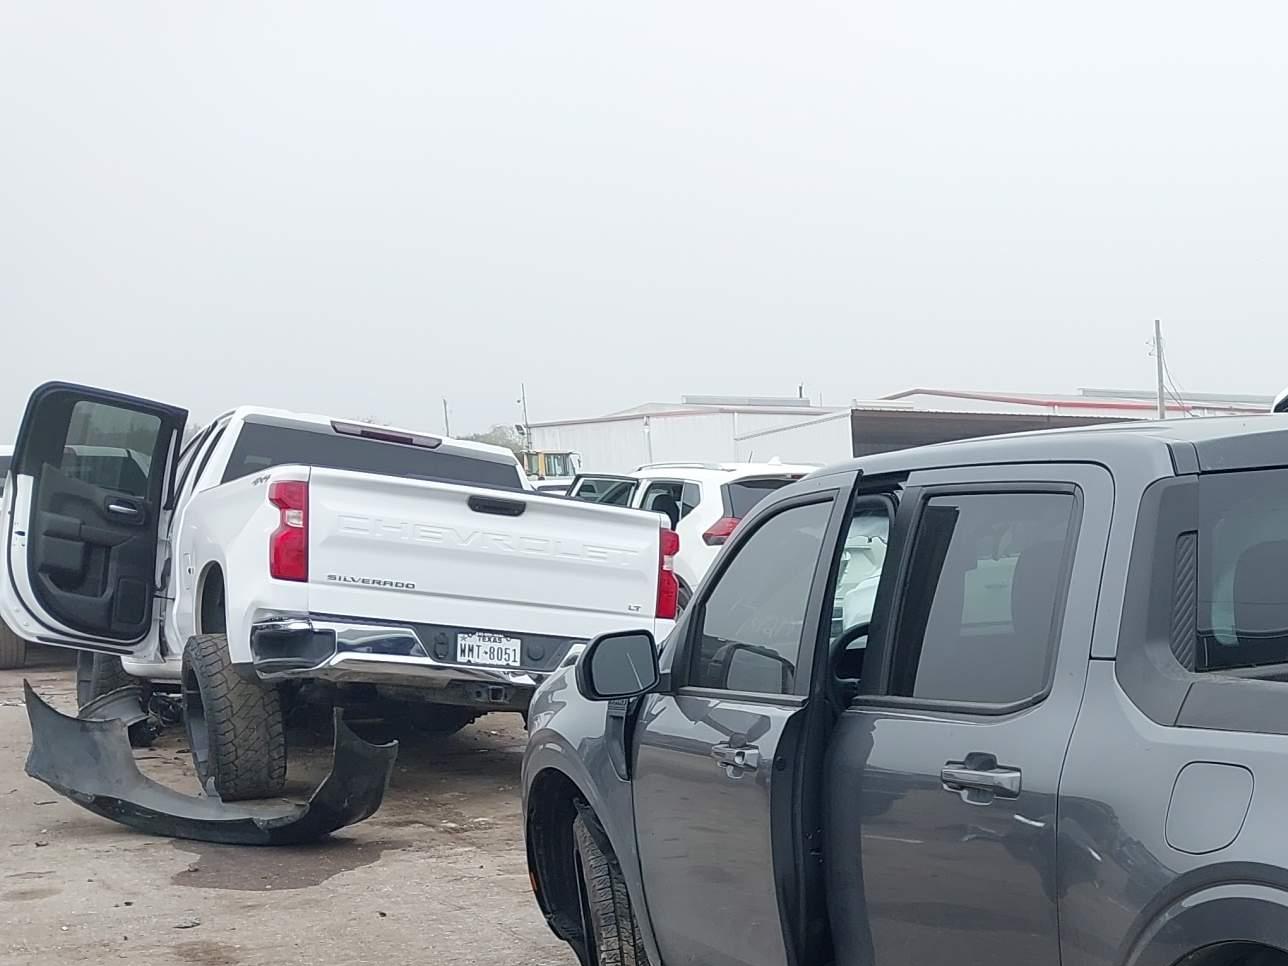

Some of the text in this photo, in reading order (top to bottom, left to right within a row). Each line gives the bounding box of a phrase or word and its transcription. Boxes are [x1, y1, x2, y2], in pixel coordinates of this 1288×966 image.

[337, 513, 641, 566] CHEVROLET
[327, 574, 416, 590] SILVERADO
[627, 604, 642, 612] LT
[478, 635, 503, 644] TEXAS
